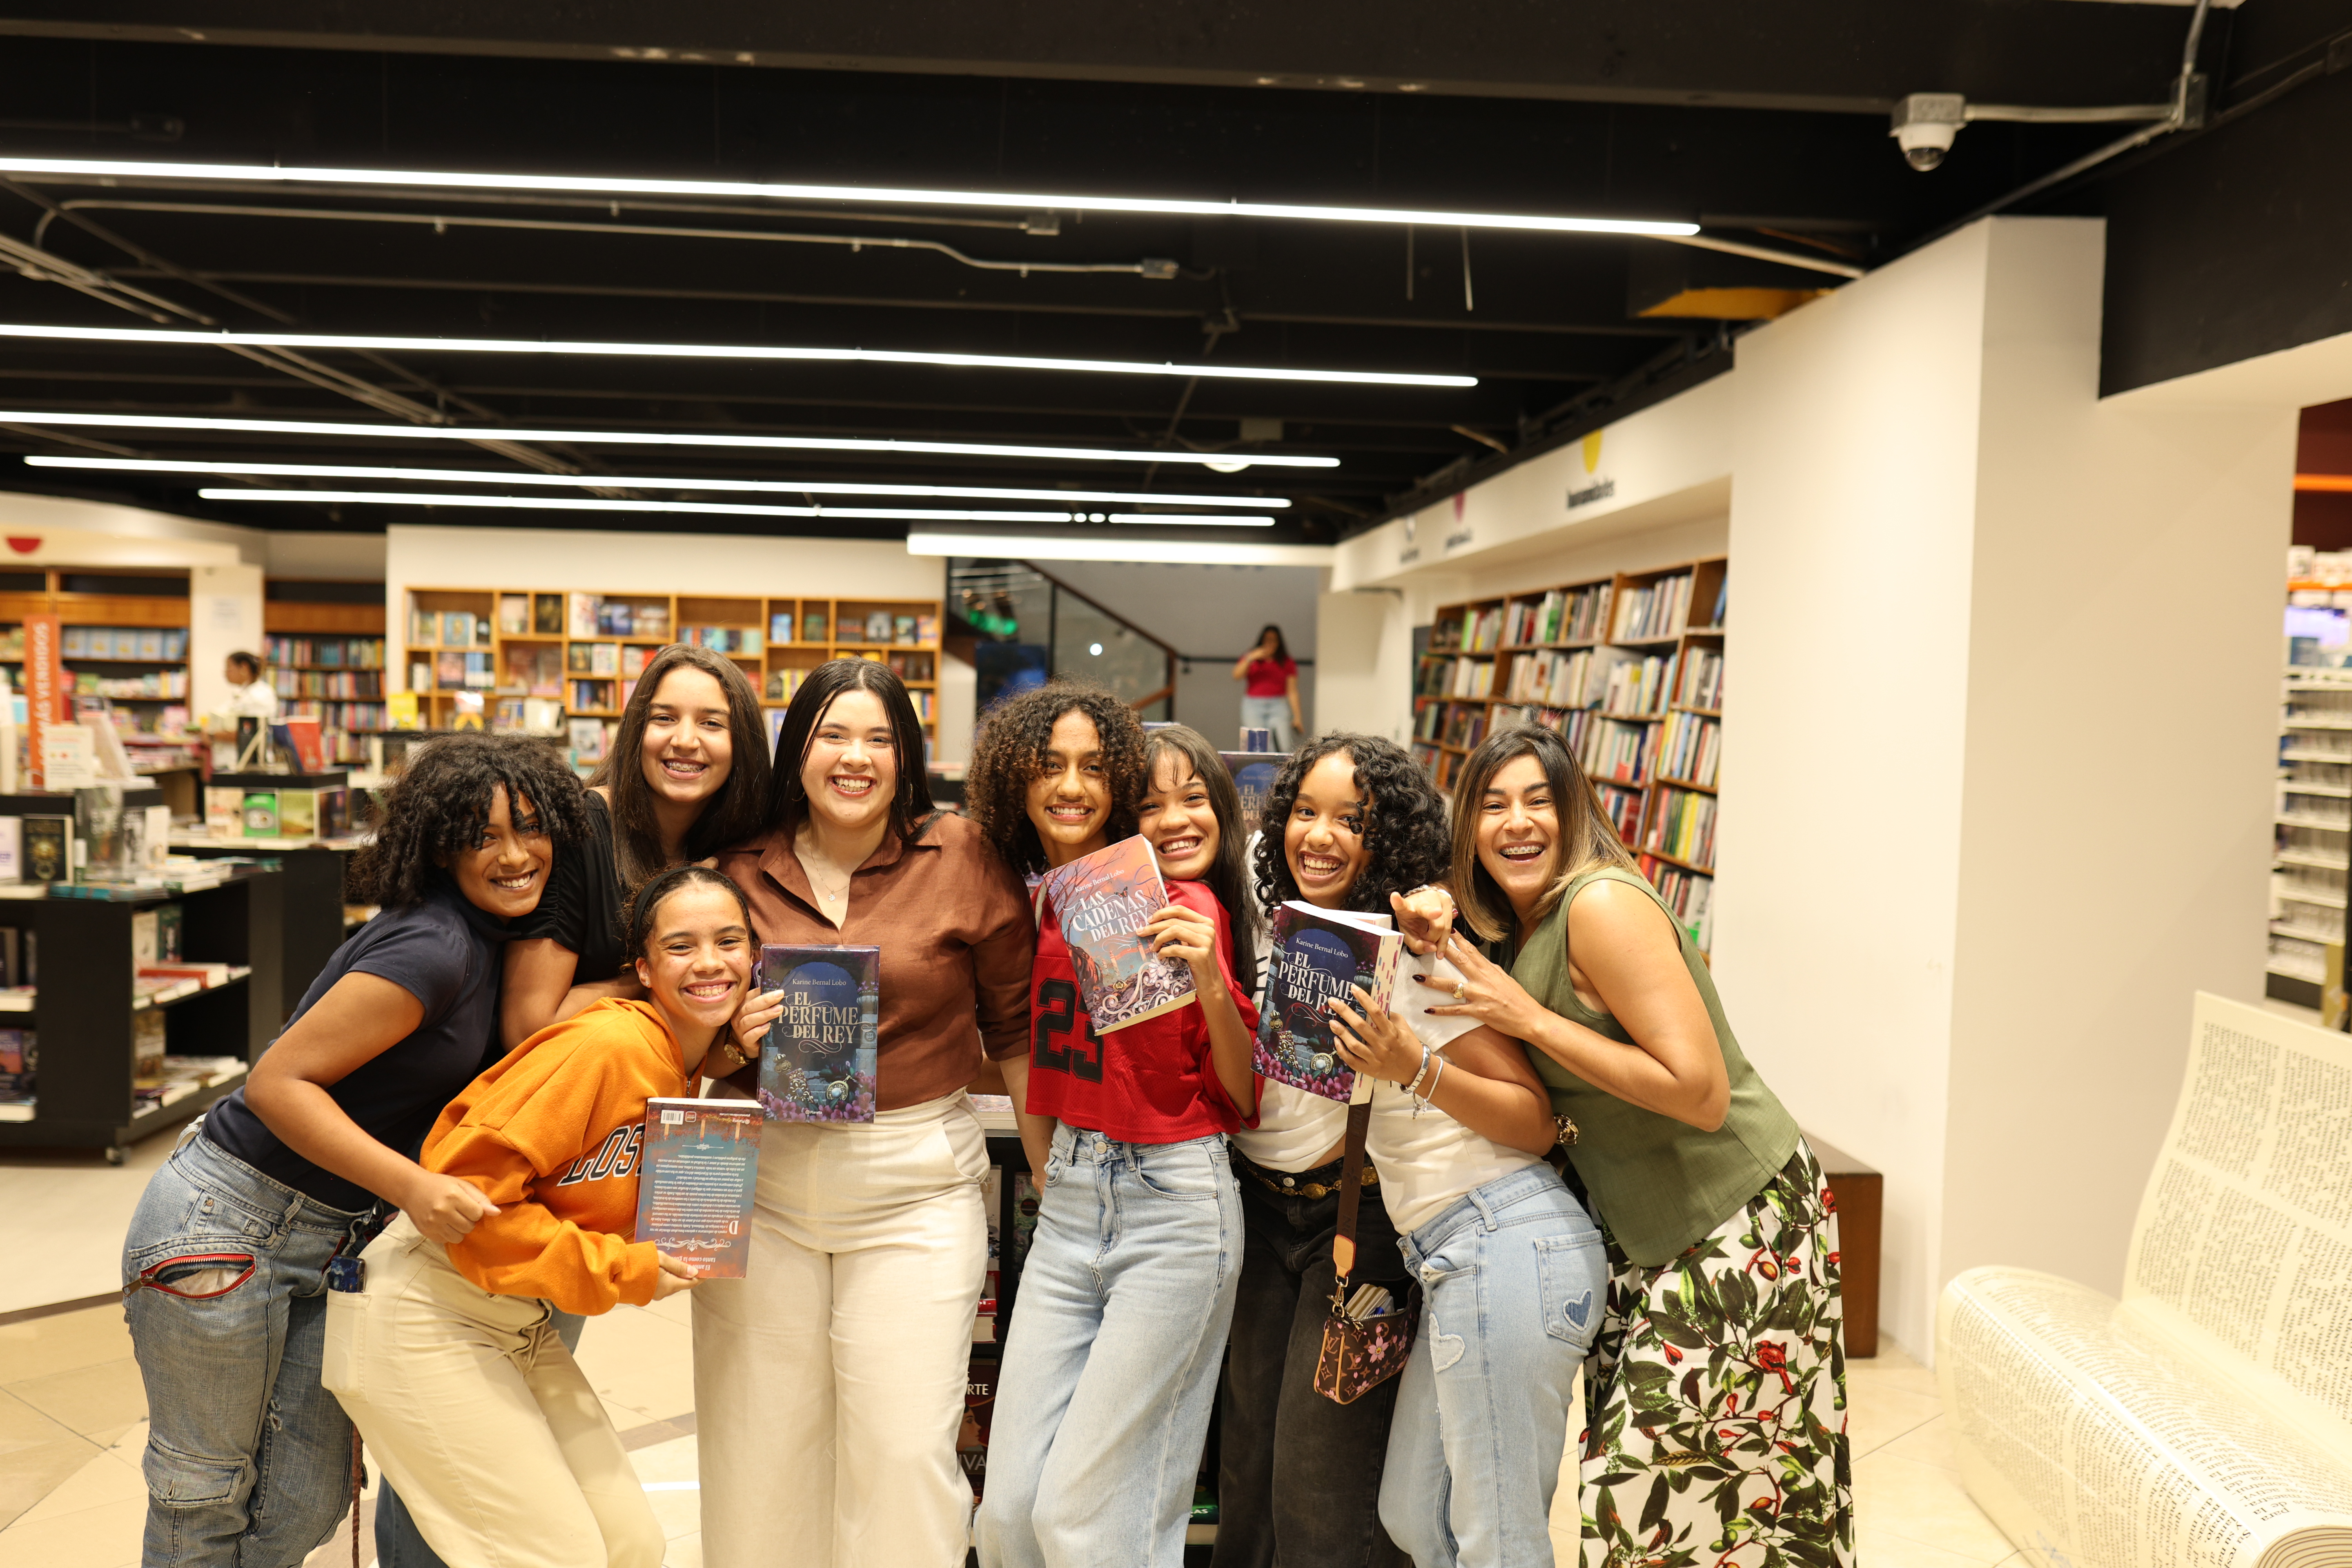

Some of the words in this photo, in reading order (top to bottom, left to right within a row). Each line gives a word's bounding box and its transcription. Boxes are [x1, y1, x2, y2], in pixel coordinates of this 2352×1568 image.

[32, 622, 51, 699] VENDIDOS
[1075, 882, 1093, 893] Karine
[1092, 875, 1111, 887] Bernal
[1110, 869, 1124, 880] Lobo
[1072, 889, 1148, 932] CADENAS
[1080, 891, 1103, 912] LAS
[1090, 922, 1118, 944] DEL
[1120, 908, 1152, 937] REY
[1296, 937, 1314, 949] Karine
[1314, 943, 1333, 954] Bernal
[1334, 948, 1348, 958] Lobo
[1294, 951, 1311, 969] EL
[1278, 960, 1357, 1002] PERFUME
[795, 992, 811, 1006] EL
[1287, 984, 1314, 1005] DEL
[779, 1007, 858, 1025] PERFUME
[792, 1025, 819, 1039] DEL
[822, 1025, 857, 1044] REY
[2327, 1362, 2334, 1372] la
[2339, 1367, 2349, 1390] vida
[2189, 1452, 2207, 1461] ser
[2203, 1459, 2235, 1472] gran-
[2223, 1480, 2243, 1491] del
[2231, 1481, 2289, 1495] construi-
[2239, 1488, 2280, 1501] activi-
[2183, 1486, 2201, 1506] Los
[2245, 1494, 2302, 1507] maestra,
[2145, 1488, 2157, 1541] hermoso.
[2158, 1475, 2185, 1548] deslizándose
[2197, 1498, 2212, 1518] dad
[2260, 1508, 2291, 1521] para
[2165, 1501, 2177, 1555] pudieron
[2215, 1516, 2236, 1544] lante
[2236, 1521, 2242, 1530] y
[2186, 1520, 2198, 1563] militar.
[2225, 1532, 2234, 1544] su
[2237, 1529, 2251, 1544] Su
[2210, 1552, 2215, 1565] al
